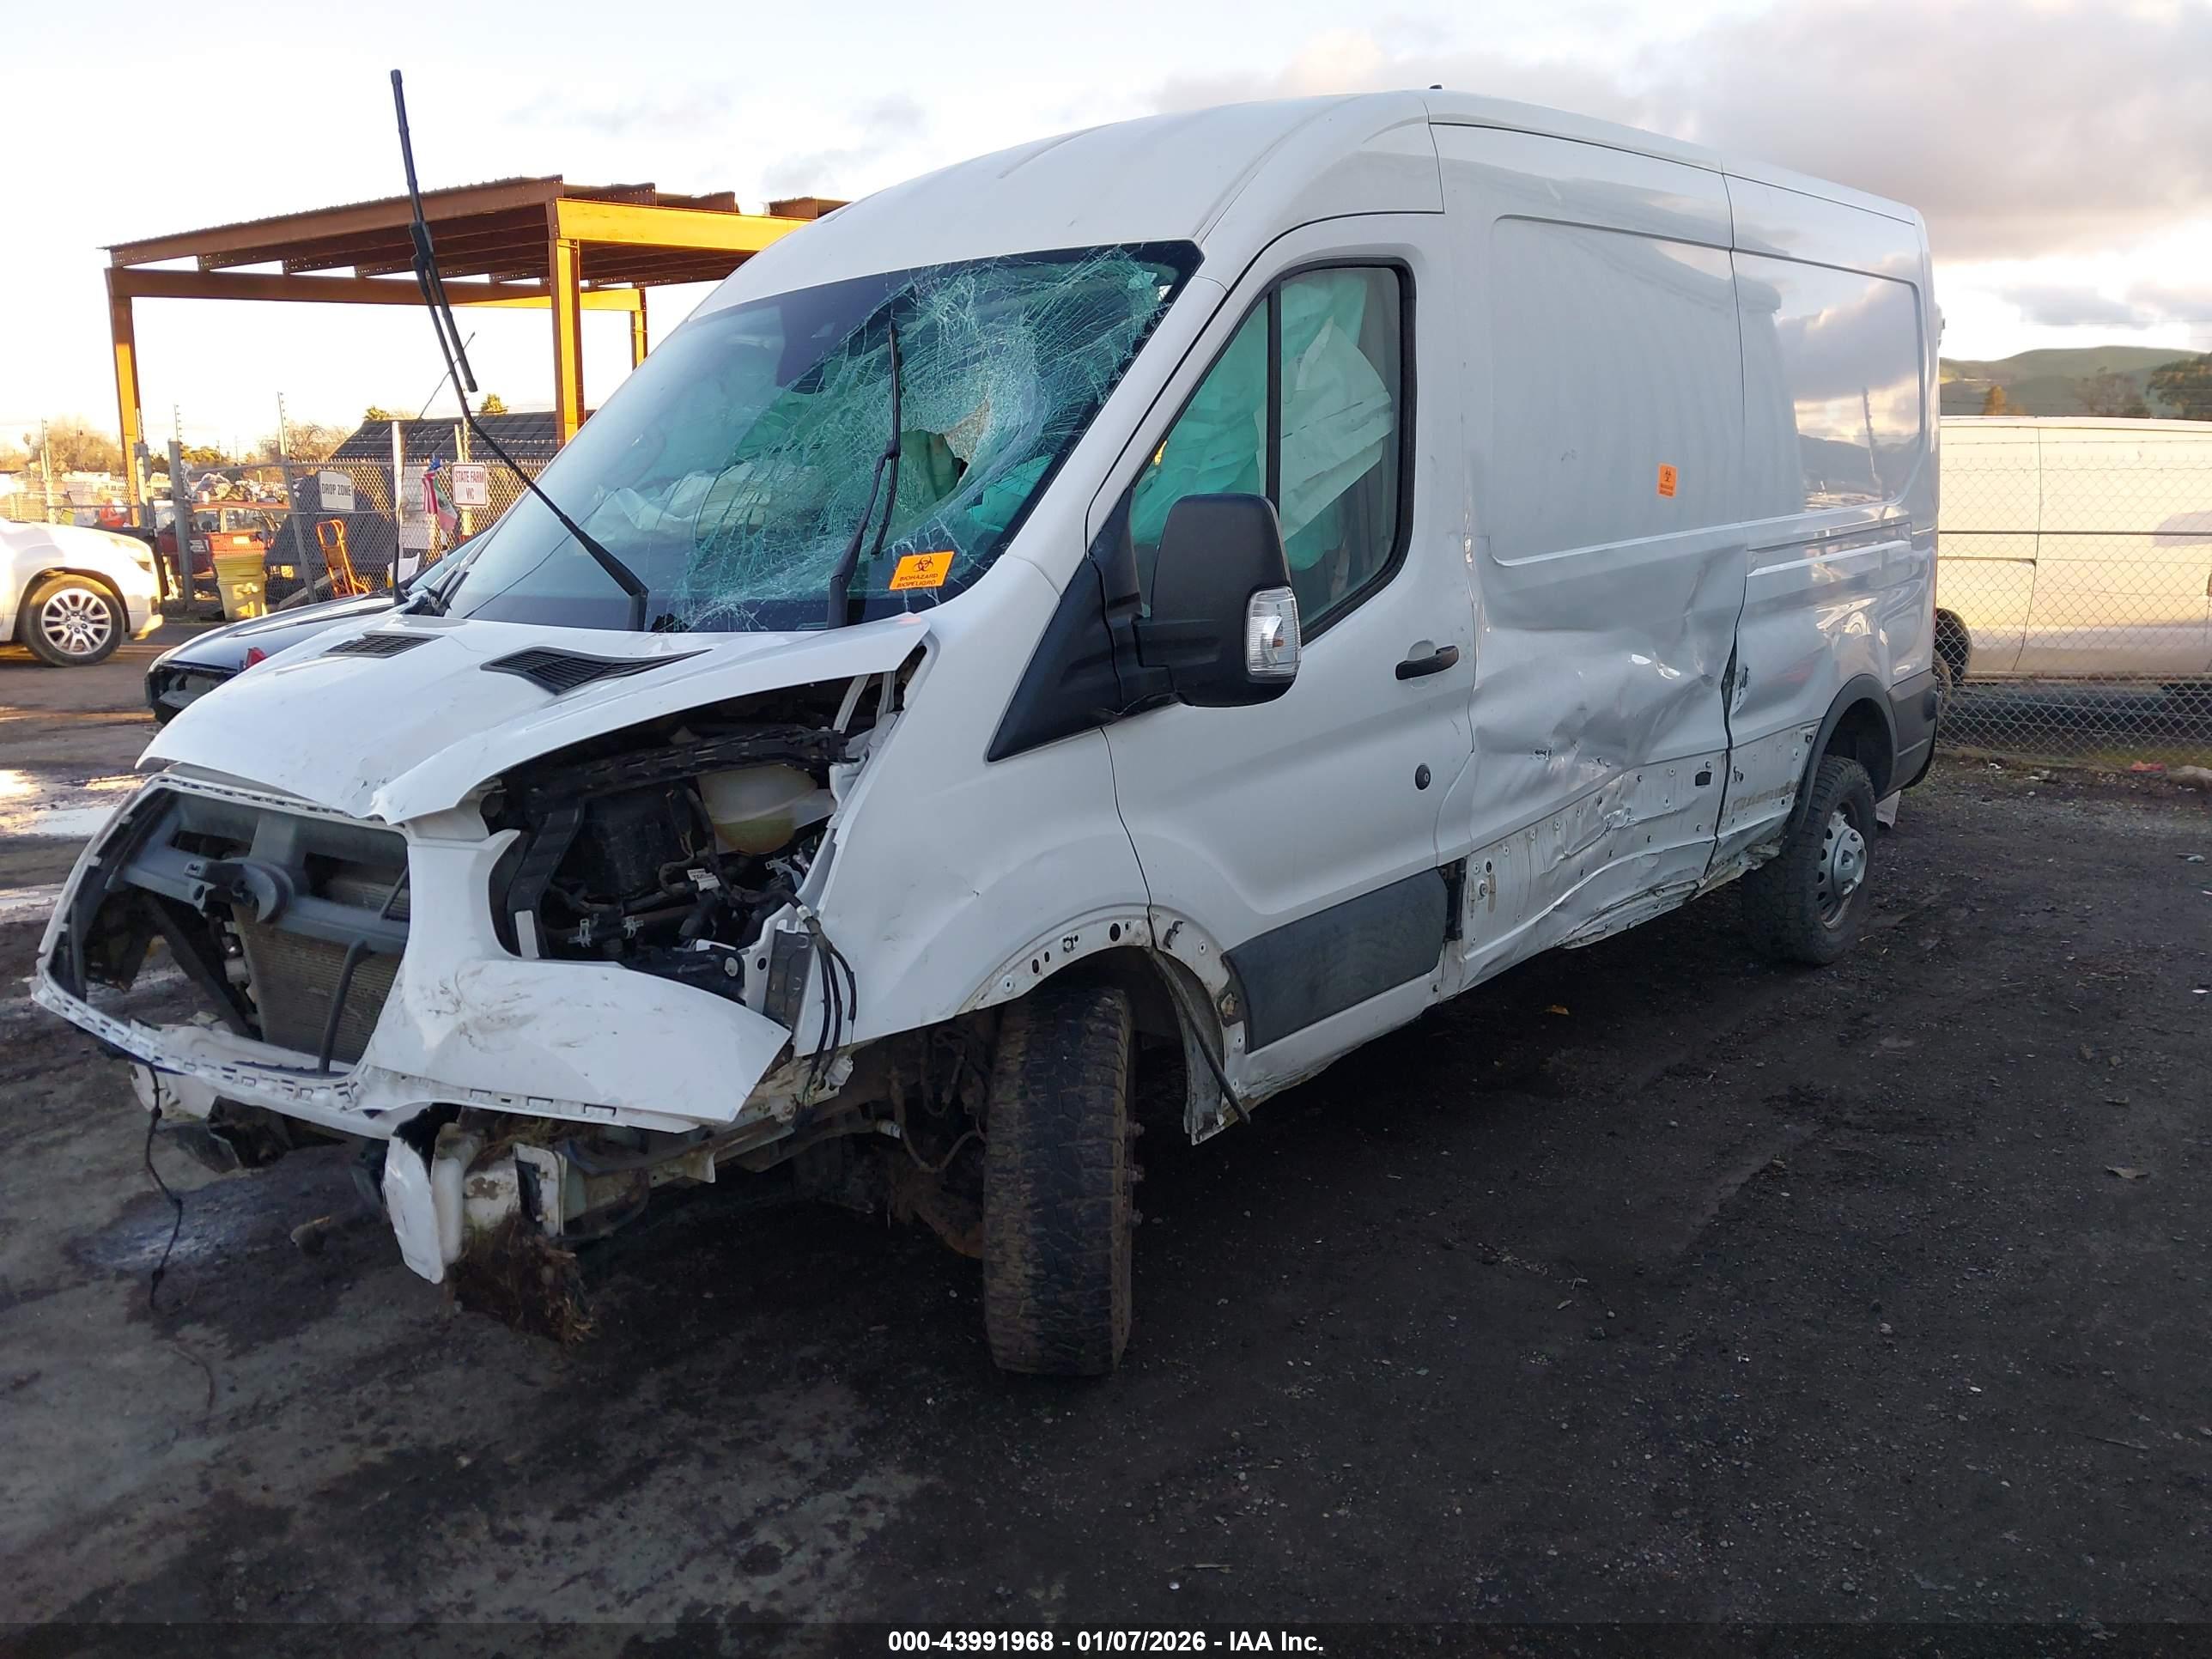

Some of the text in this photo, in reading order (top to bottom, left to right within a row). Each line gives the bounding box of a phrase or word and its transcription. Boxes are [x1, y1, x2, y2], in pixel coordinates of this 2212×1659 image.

[455, 471, 483, 483] STATE FARM
[321, 483, 351, 496] DROP ZONE
[465, 487, 475, 500] VIC
[899, 573, 939, 581] BIOHAZARD
